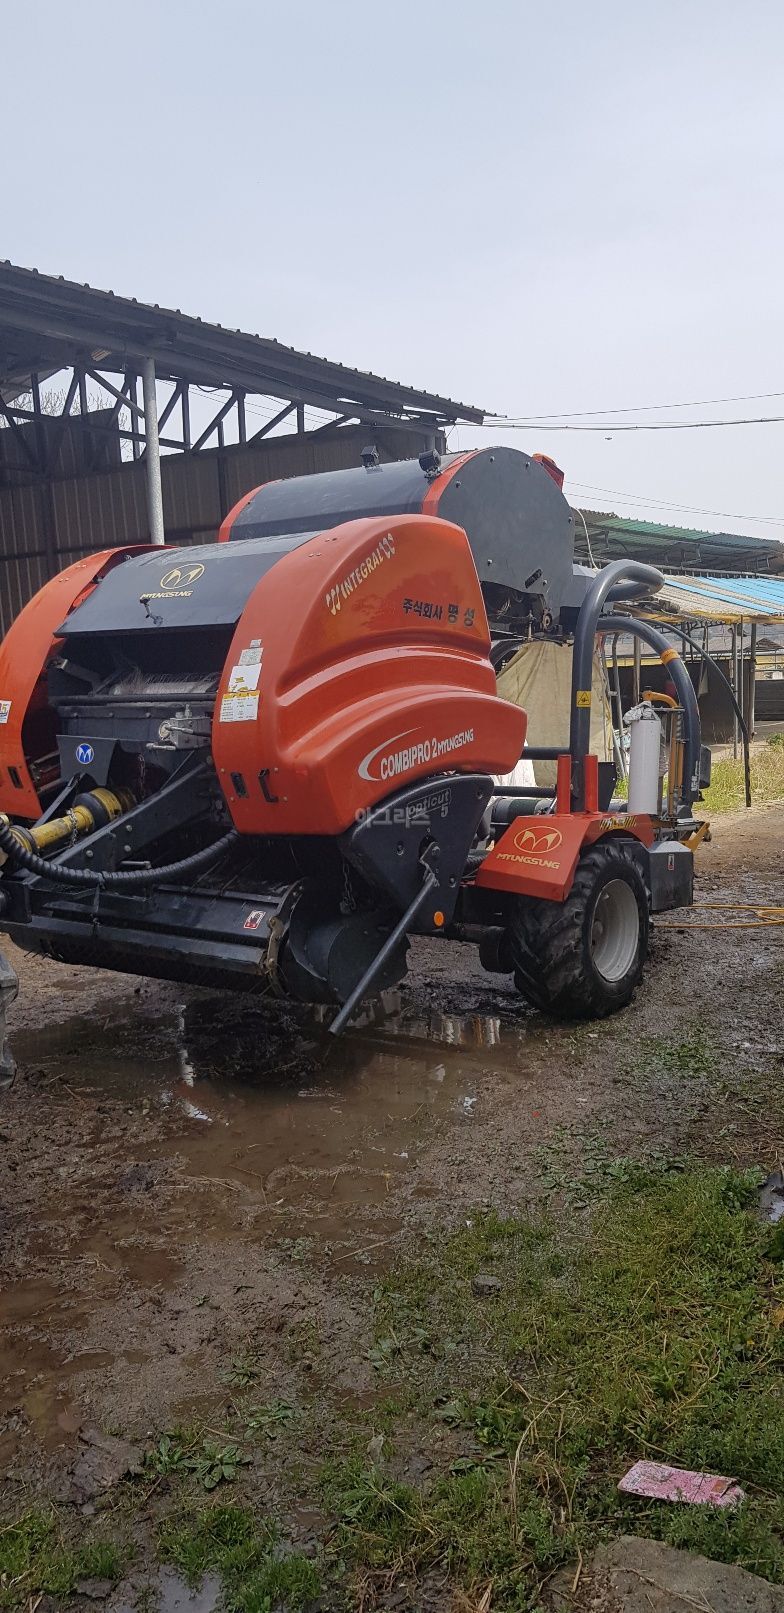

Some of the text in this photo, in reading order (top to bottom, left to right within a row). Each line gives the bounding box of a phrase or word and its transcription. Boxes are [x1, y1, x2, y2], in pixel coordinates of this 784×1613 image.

[140, 590, 193, 600] MYUNGSUNG
[403, 598, 443, 620] 주식회사
[380, 728, 474, 780] COMBIPRO 2 MYUNGSUNG
[441, 803, 449, 818] 5
[496, 853, 561, 870] MYUNGSUNG
